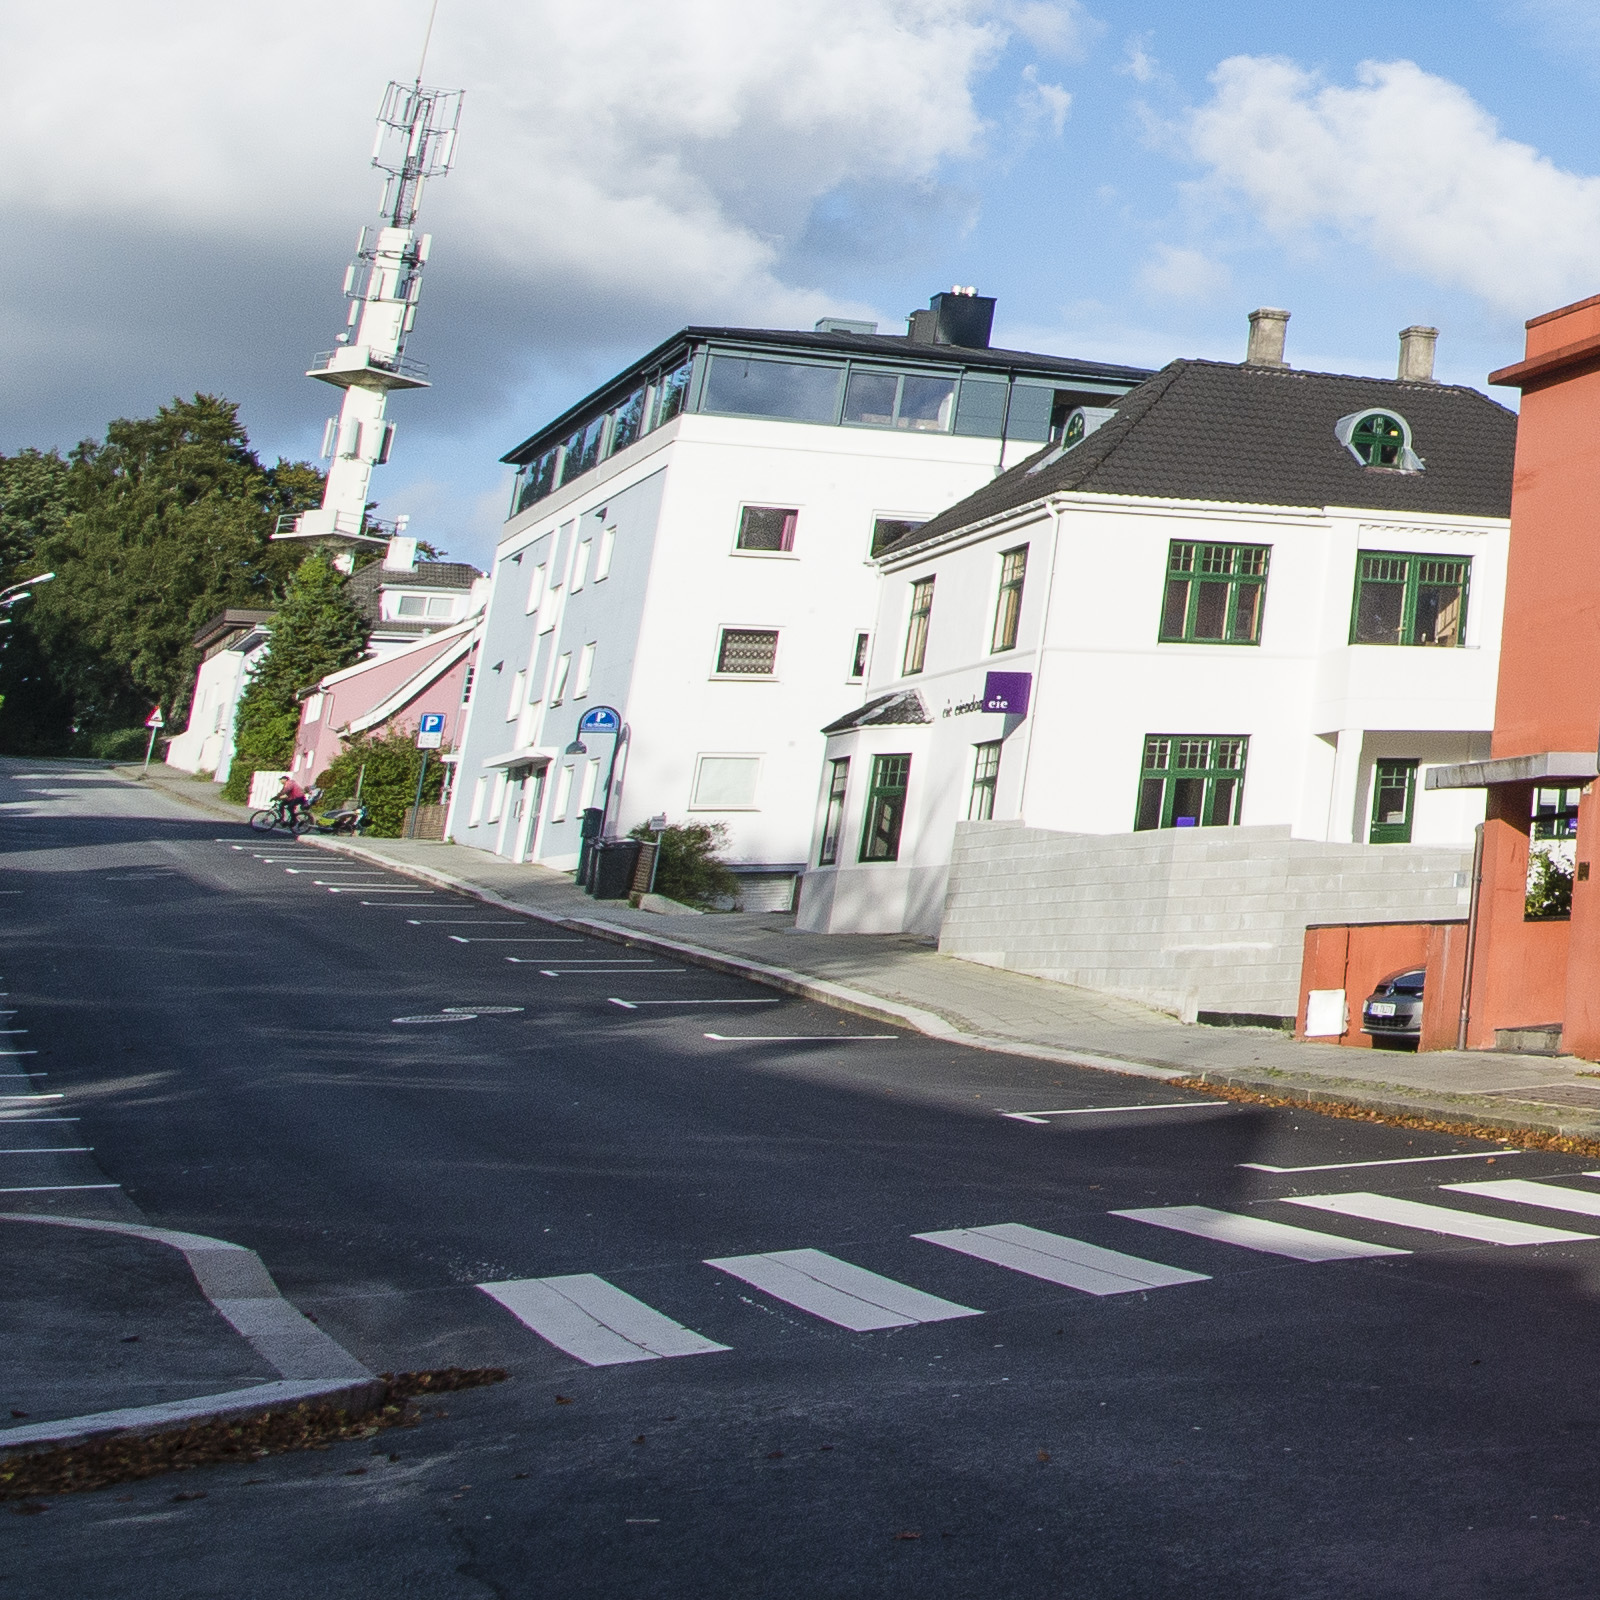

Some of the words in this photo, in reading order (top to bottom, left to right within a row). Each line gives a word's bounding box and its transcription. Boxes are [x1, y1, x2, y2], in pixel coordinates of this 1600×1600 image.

[988, 695, 1008, 709] eie
[425, 716, 440, 732] P
[597, 711, 607, 723] P
